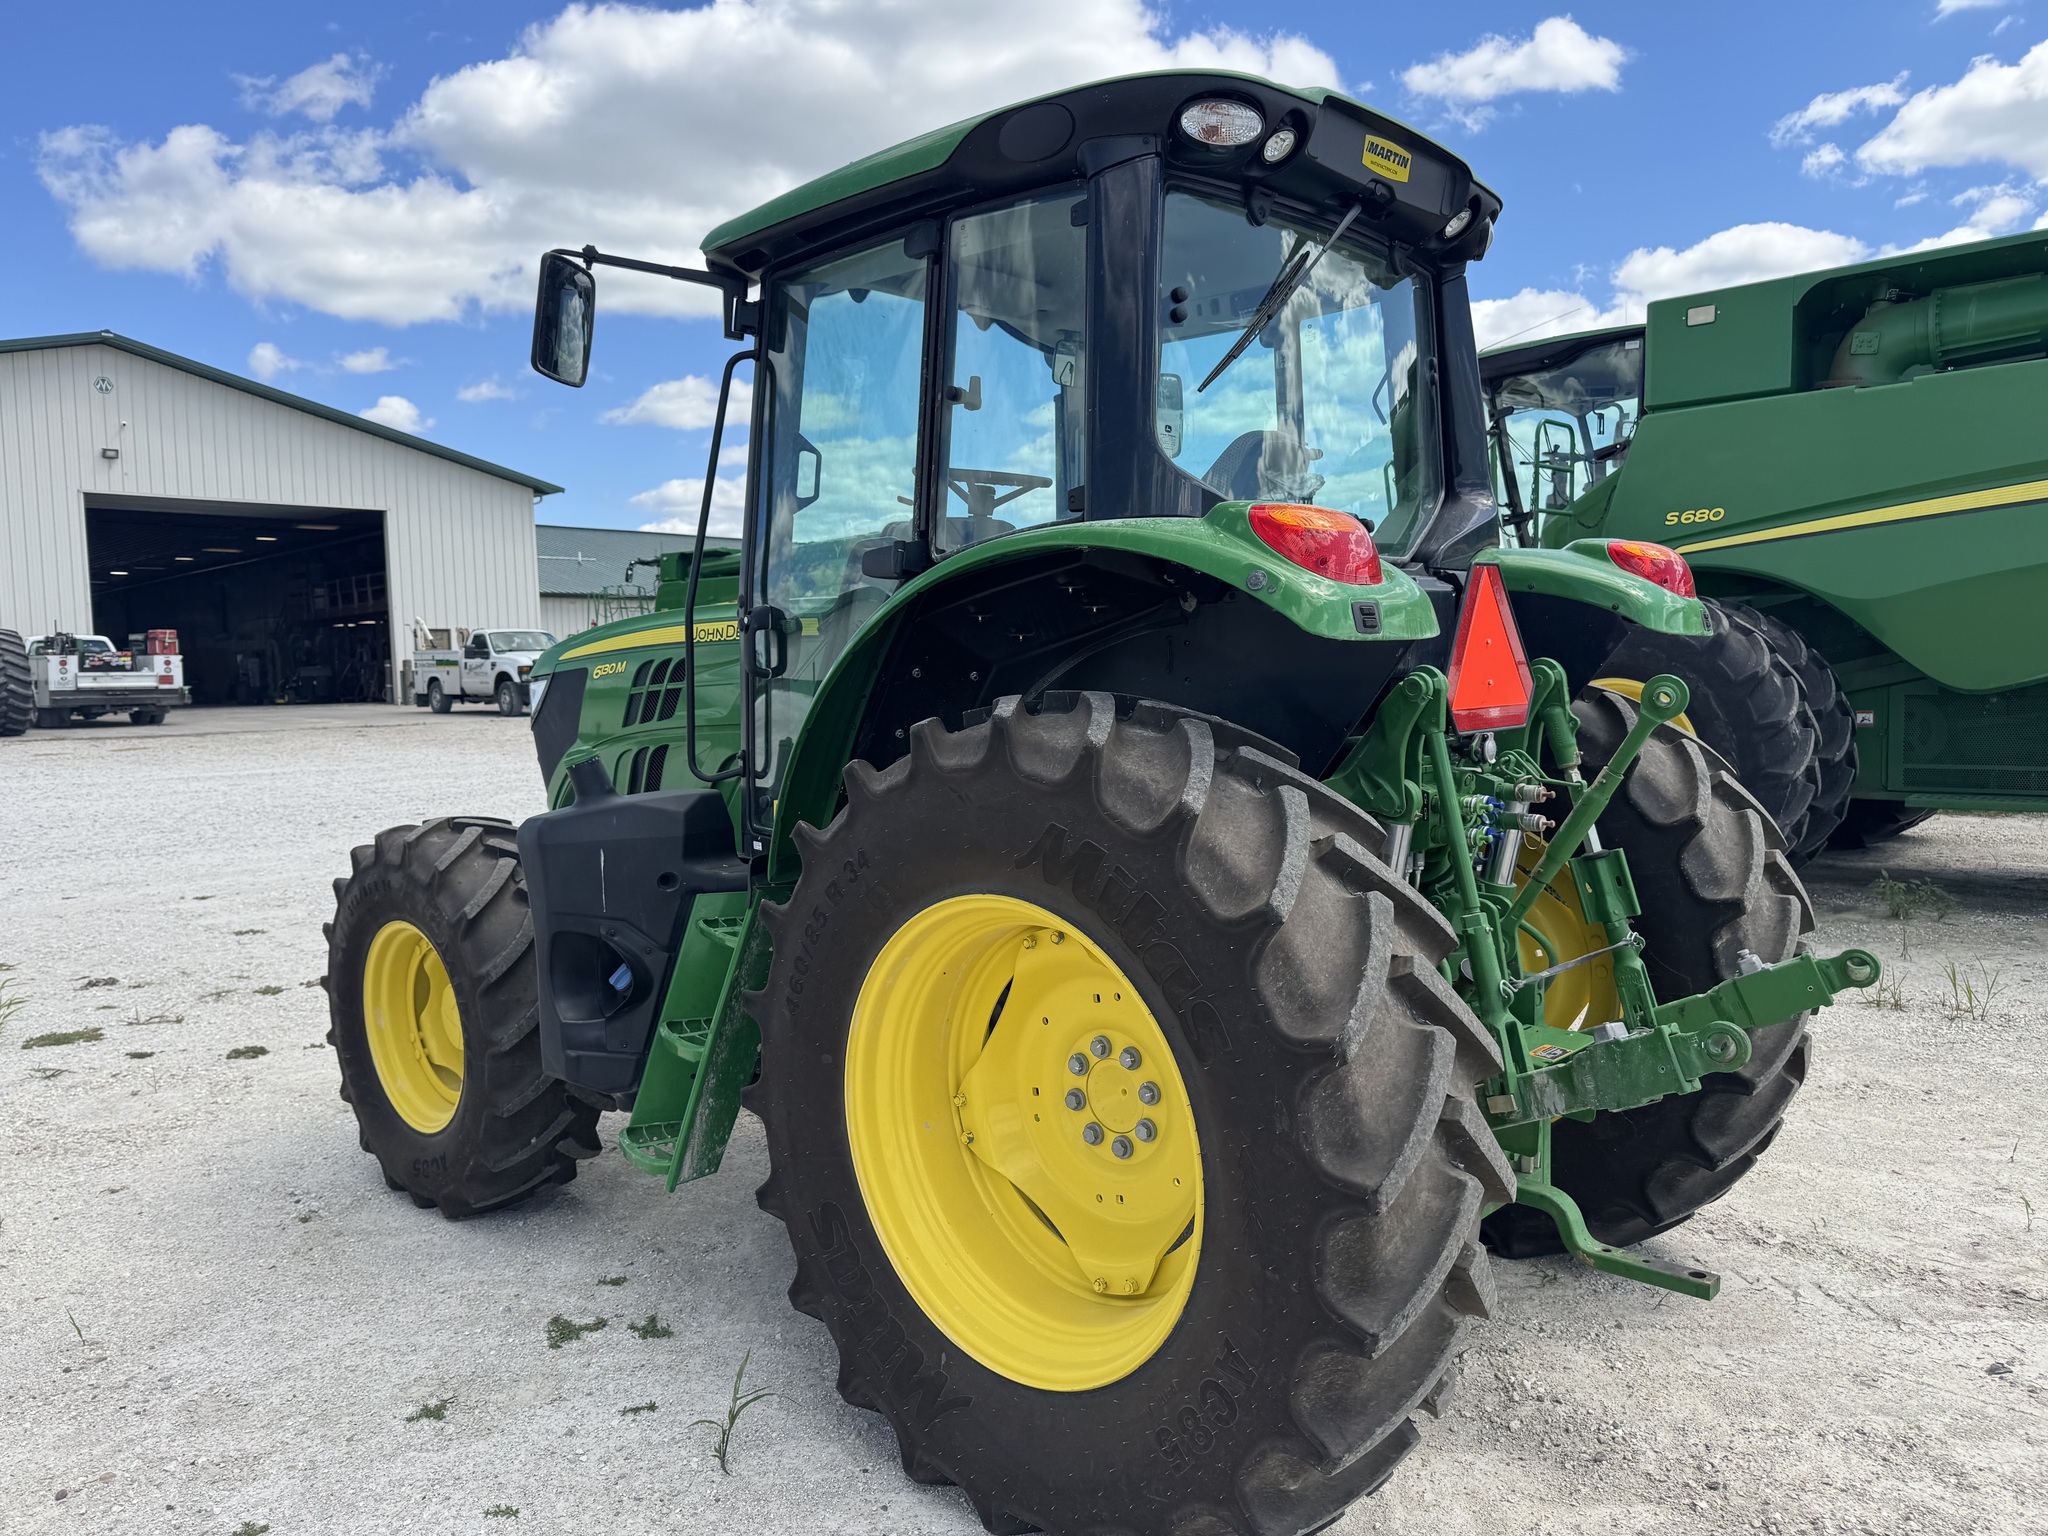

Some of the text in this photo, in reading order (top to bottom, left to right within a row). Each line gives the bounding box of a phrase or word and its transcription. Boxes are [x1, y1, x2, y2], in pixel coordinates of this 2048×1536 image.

[1366, 140, 1409, 169] MARTIN
[693, 626, 724, 640] JOHN
[786, 904, 828, 1016] 460/85
[1154, 1335, 1259, 1477] AC85
